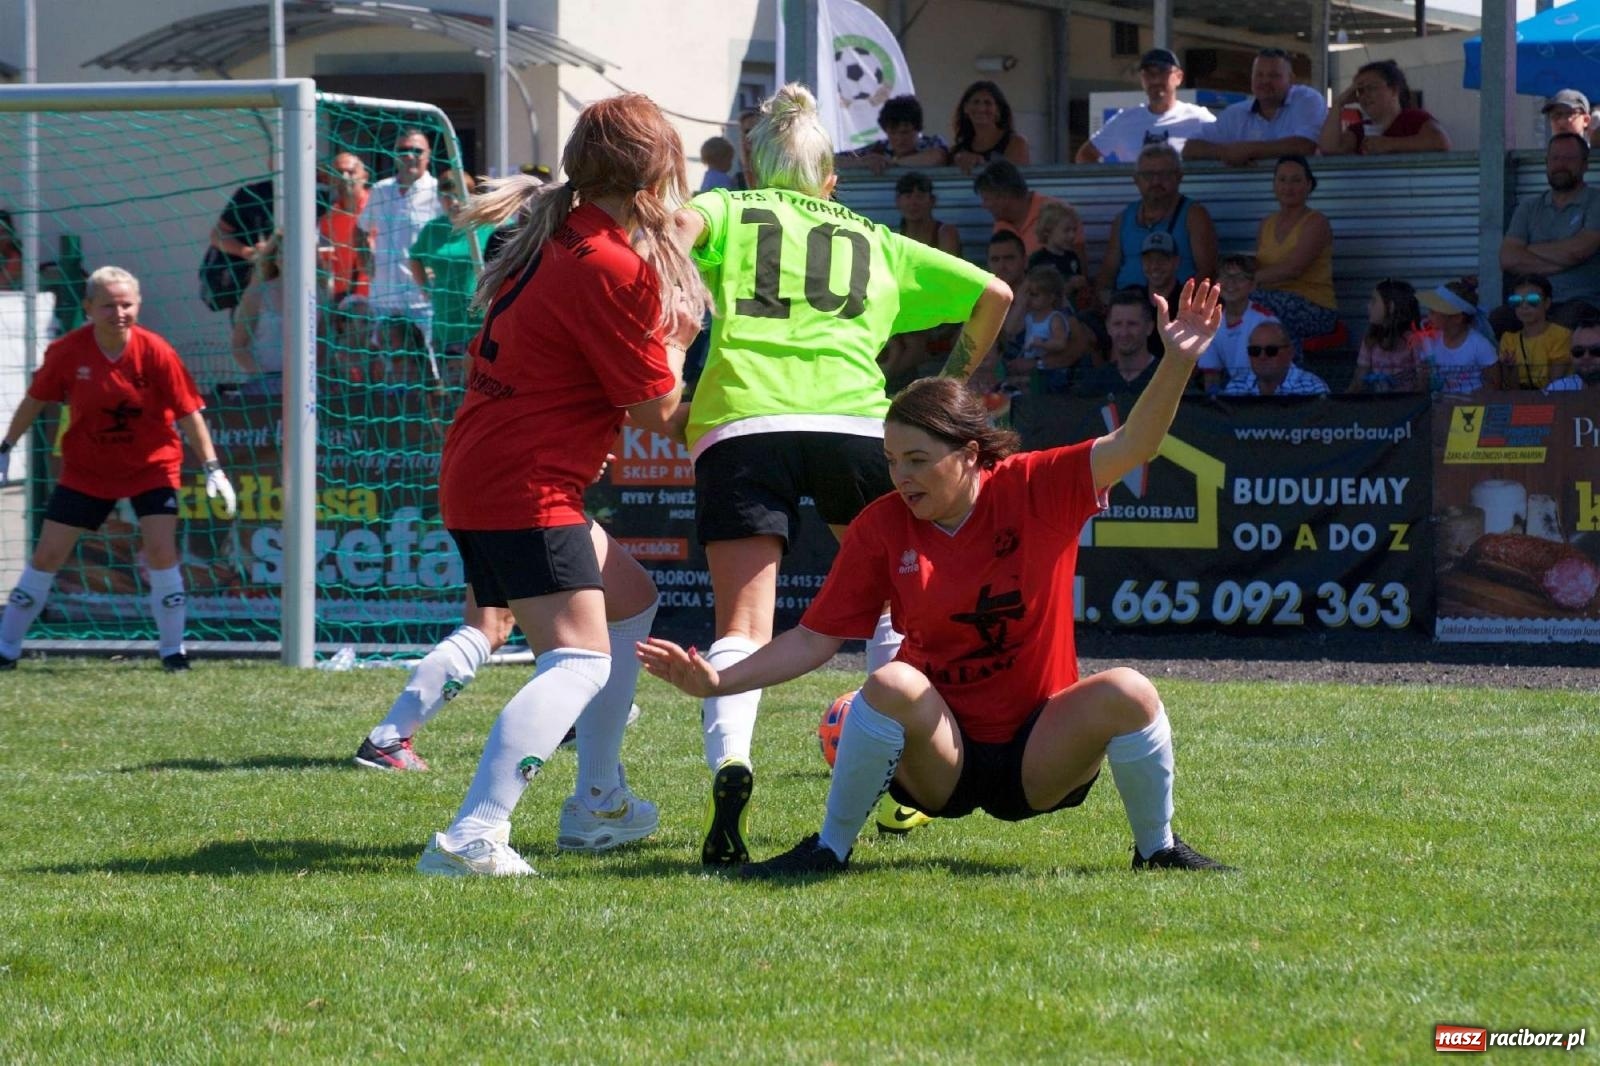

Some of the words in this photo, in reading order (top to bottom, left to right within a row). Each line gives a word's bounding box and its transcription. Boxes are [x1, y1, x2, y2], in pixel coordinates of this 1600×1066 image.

[735, 206, 872, 320] 10
[1234, 421, 1412, 446] www.gregorbau.pl
[622, 465, 669, 480] SKLEP
[673, 465, 693, 480] RY
[621, 491, 654, 505] RYBY
[658, 488, 697, 505] ŚWIEŻ
[1233, 476, 1411, 506] BUDUJEMY
[1100, 505, 1196, 521] REGORBAU
[1233, 522, 1283, 551] OD
[1295, 523, 1319, 551] A
[1329, 523, 1377, 551] DO
[1388, 523, 1411, 551] Z
[1111, 579, 1201, 625] 665
[1211, 580, 1305, 627] 092
[1316, 581, 1411, 630] 363
